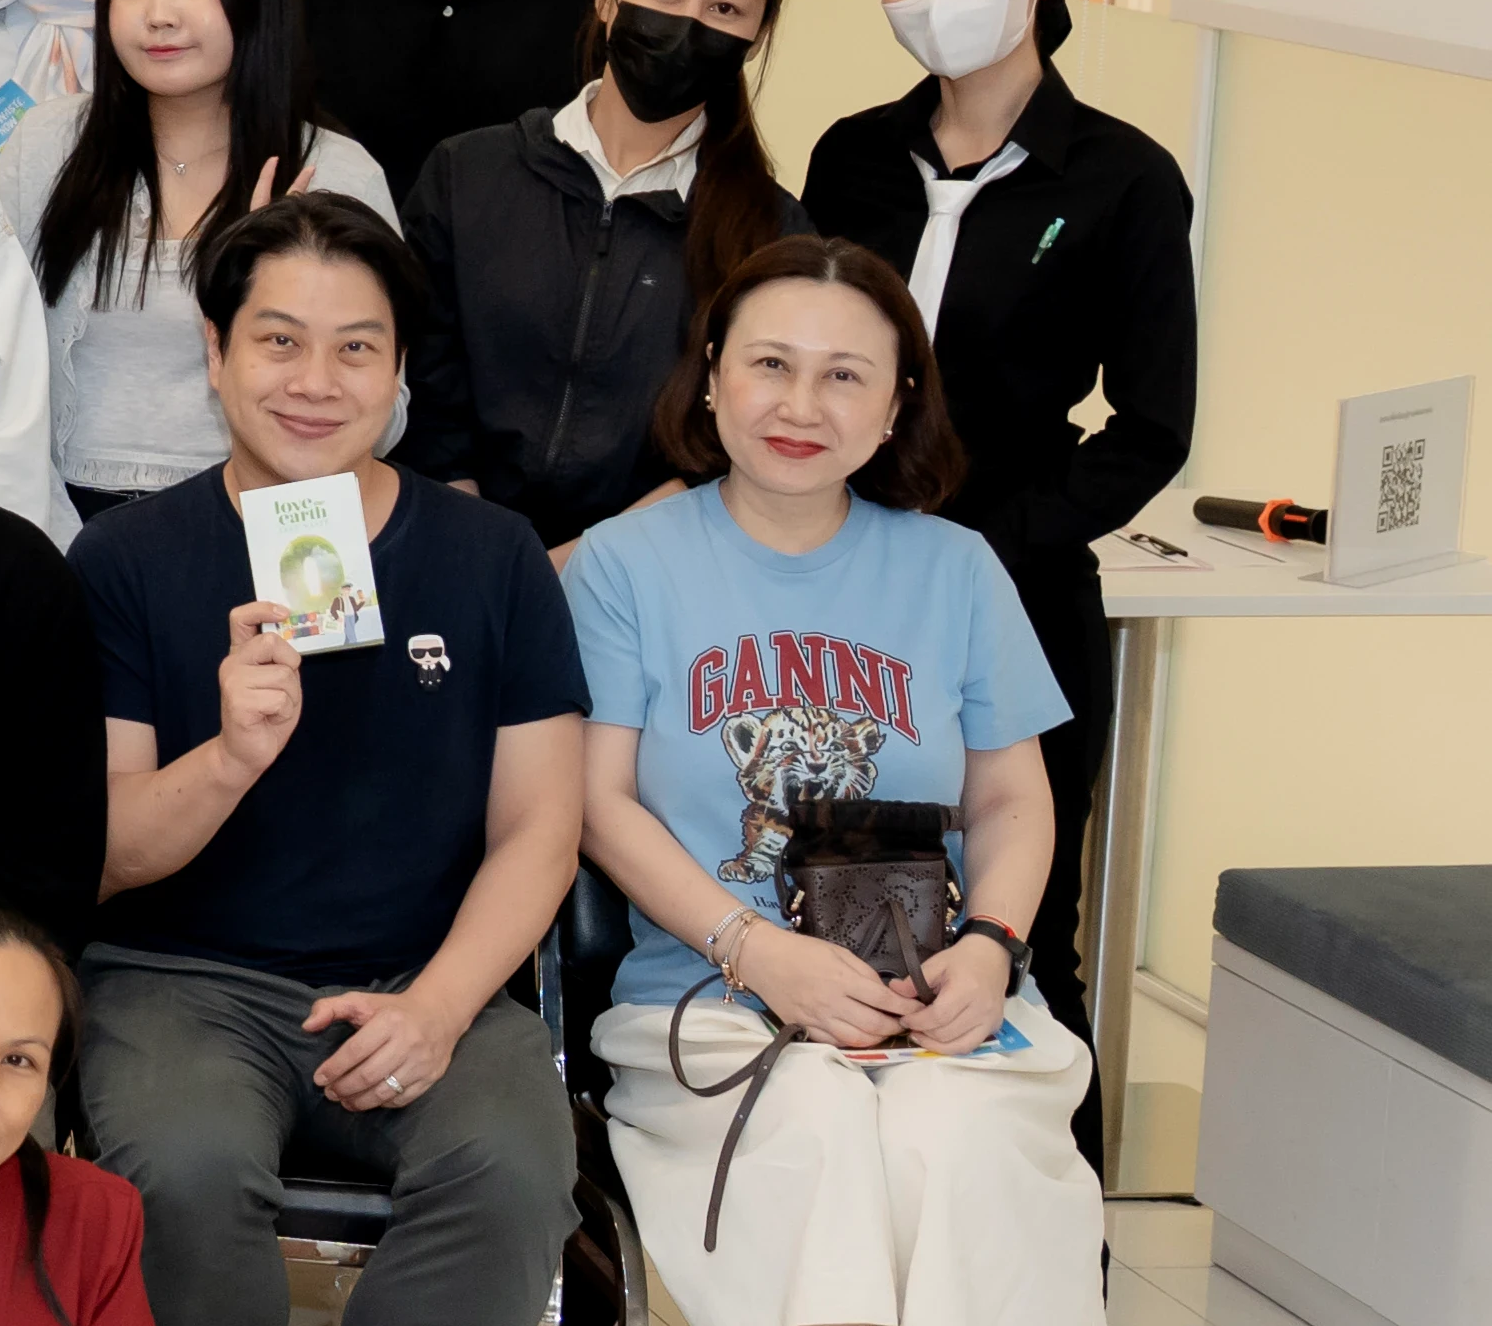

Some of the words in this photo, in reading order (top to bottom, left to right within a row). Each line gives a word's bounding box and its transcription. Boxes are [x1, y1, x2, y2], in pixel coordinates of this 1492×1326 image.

[274, 497, 313, 516] love
[278, 505, 328, 526] earth
[688, 629, 921, 746] GANNI
